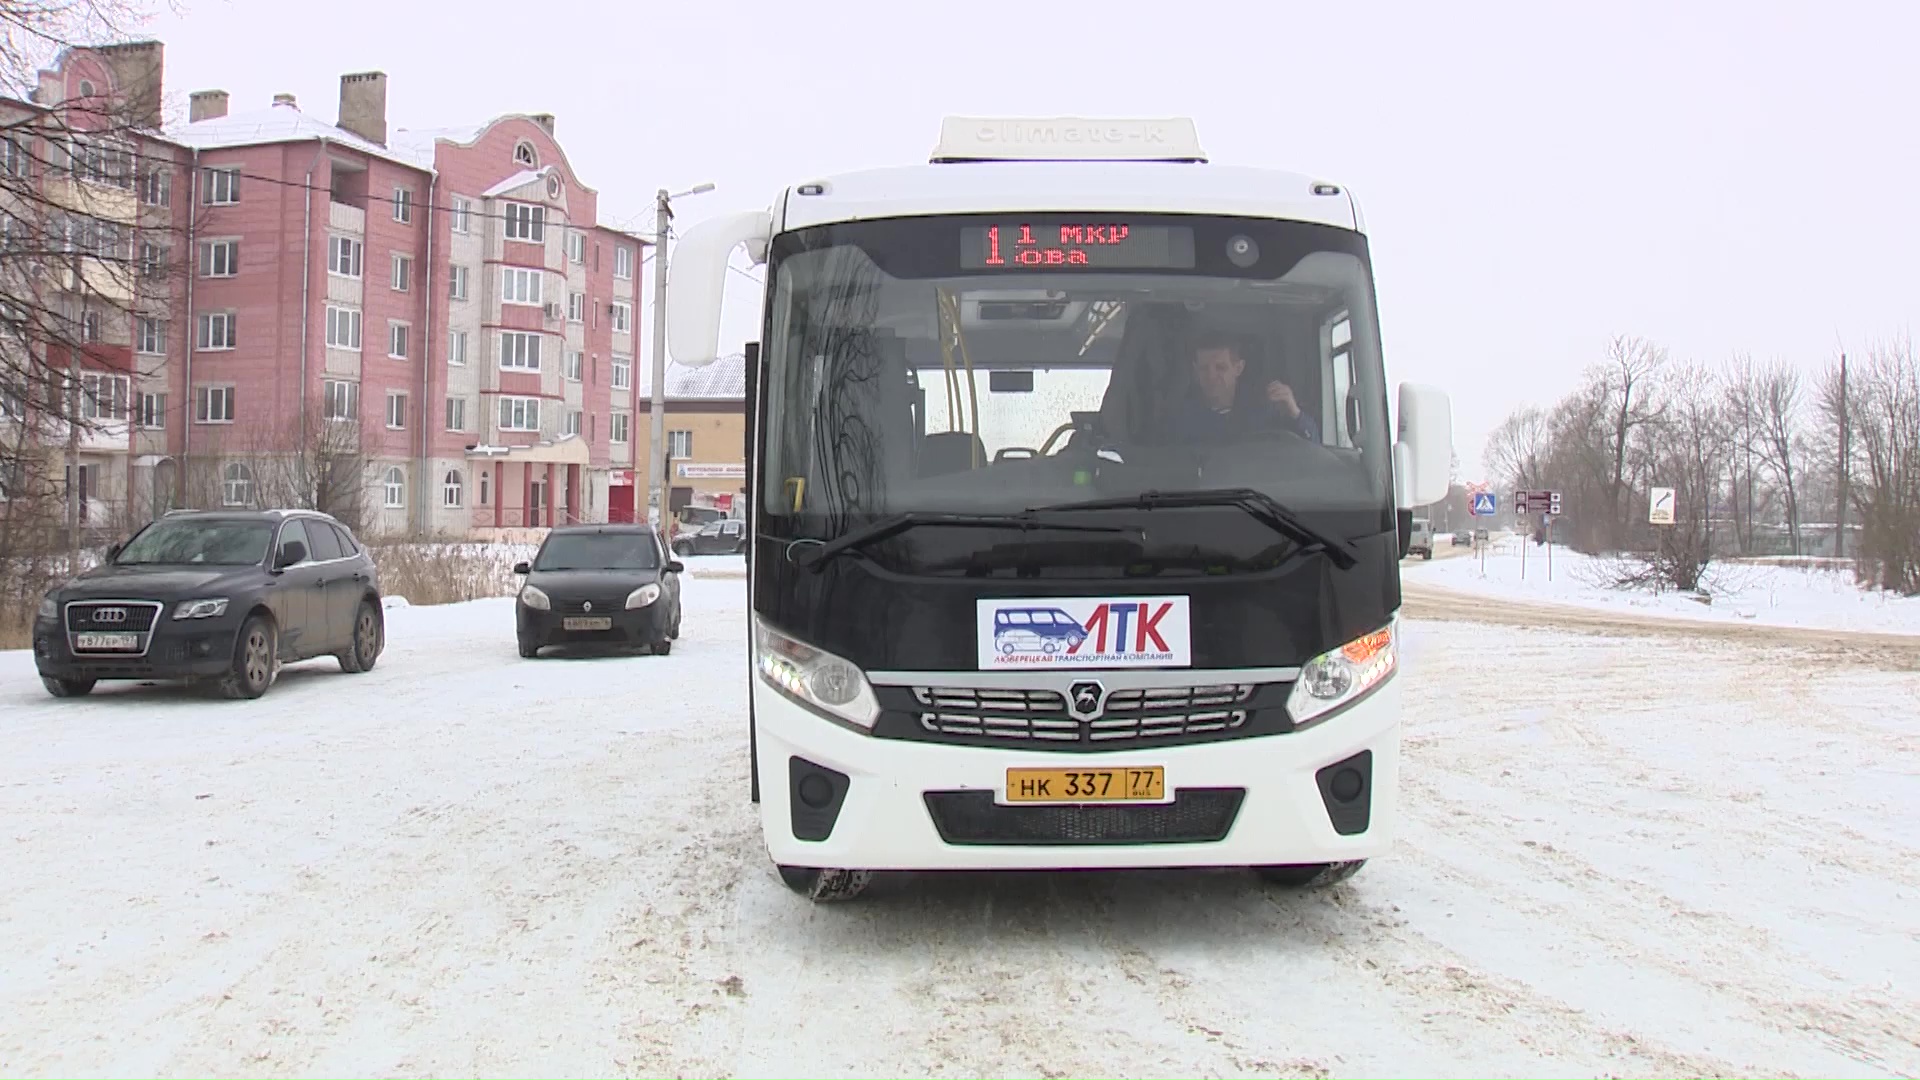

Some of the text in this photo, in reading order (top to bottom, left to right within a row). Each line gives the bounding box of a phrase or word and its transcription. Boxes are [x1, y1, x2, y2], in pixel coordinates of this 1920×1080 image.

[976, 120, 1165, 143] climate-k
[985, 225, 1005, 265] 1
[1017, 225, 1036, 244] 1
[1066, 602, 1174, 655] ЛТК
[1020, 773, 1113, 796] НК 337
[1129, 771, 1154, 788] 77
